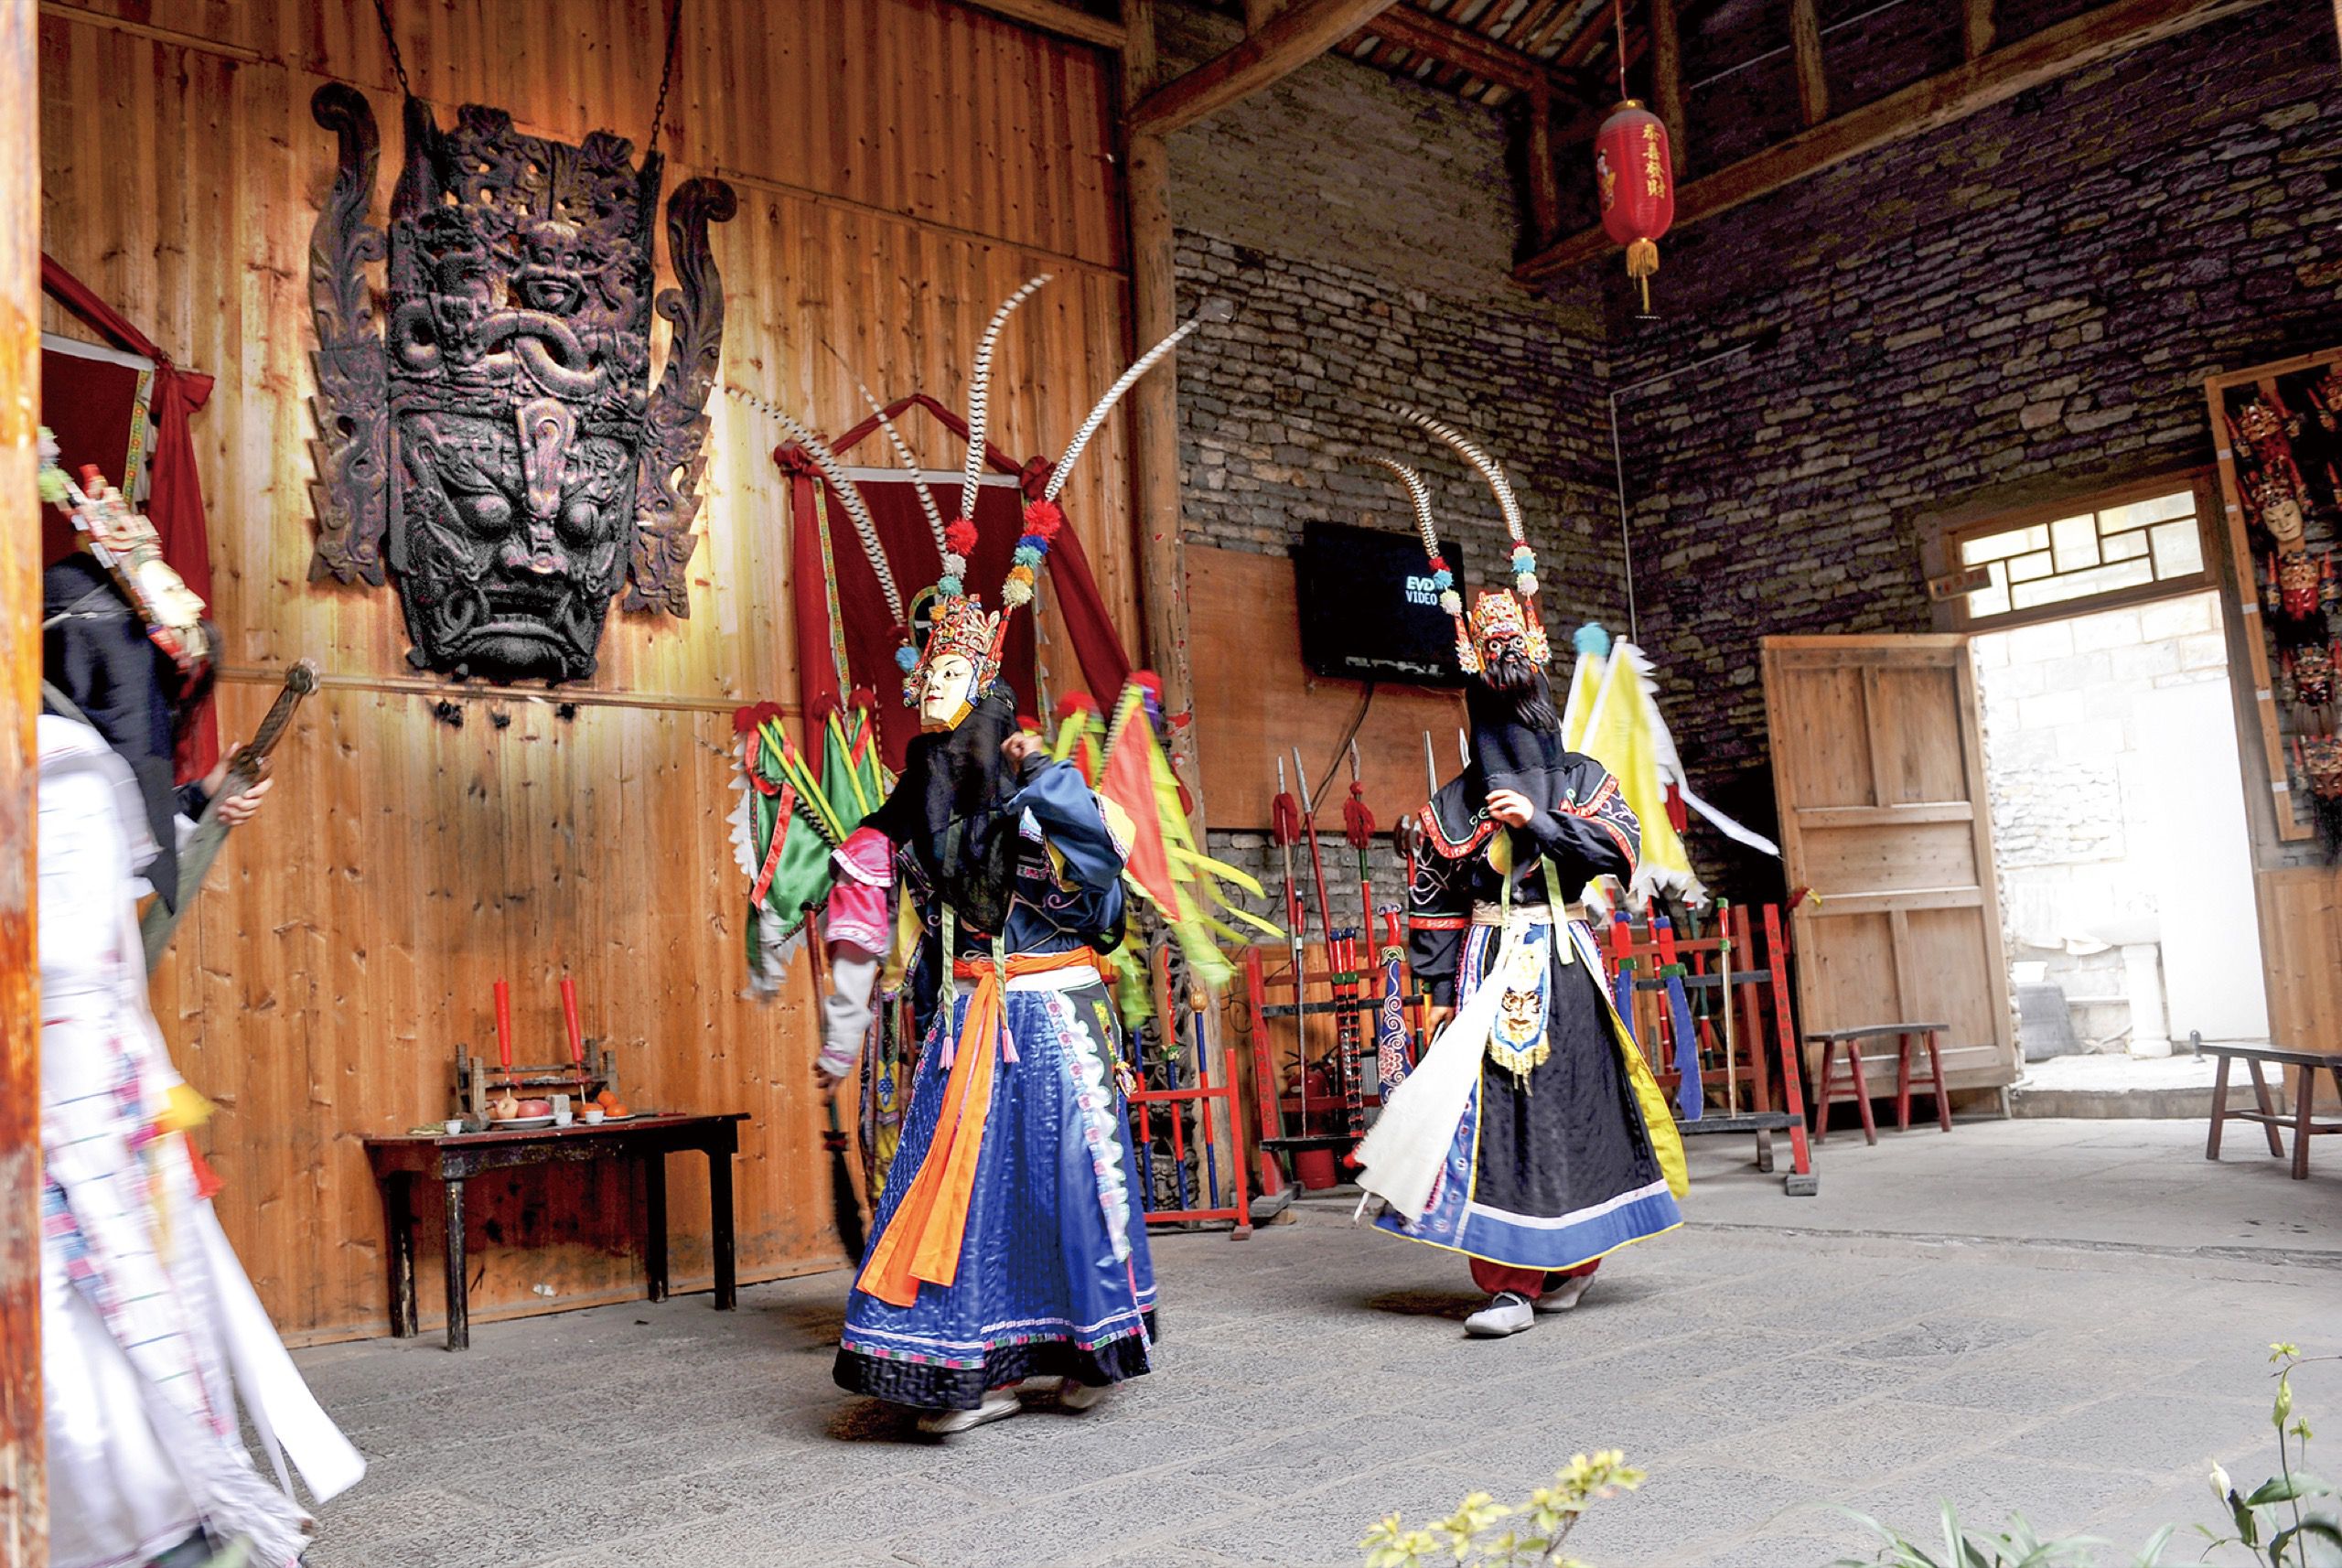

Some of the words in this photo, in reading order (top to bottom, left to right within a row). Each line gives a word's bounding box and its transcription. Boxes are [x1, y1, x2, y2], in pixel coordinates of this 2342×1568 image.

[1642, 123, 1666, 199] 恭喜發財
[1406, 575, 1435, 591] EVD
[1405, 590, 1438, 606] VIDEO
